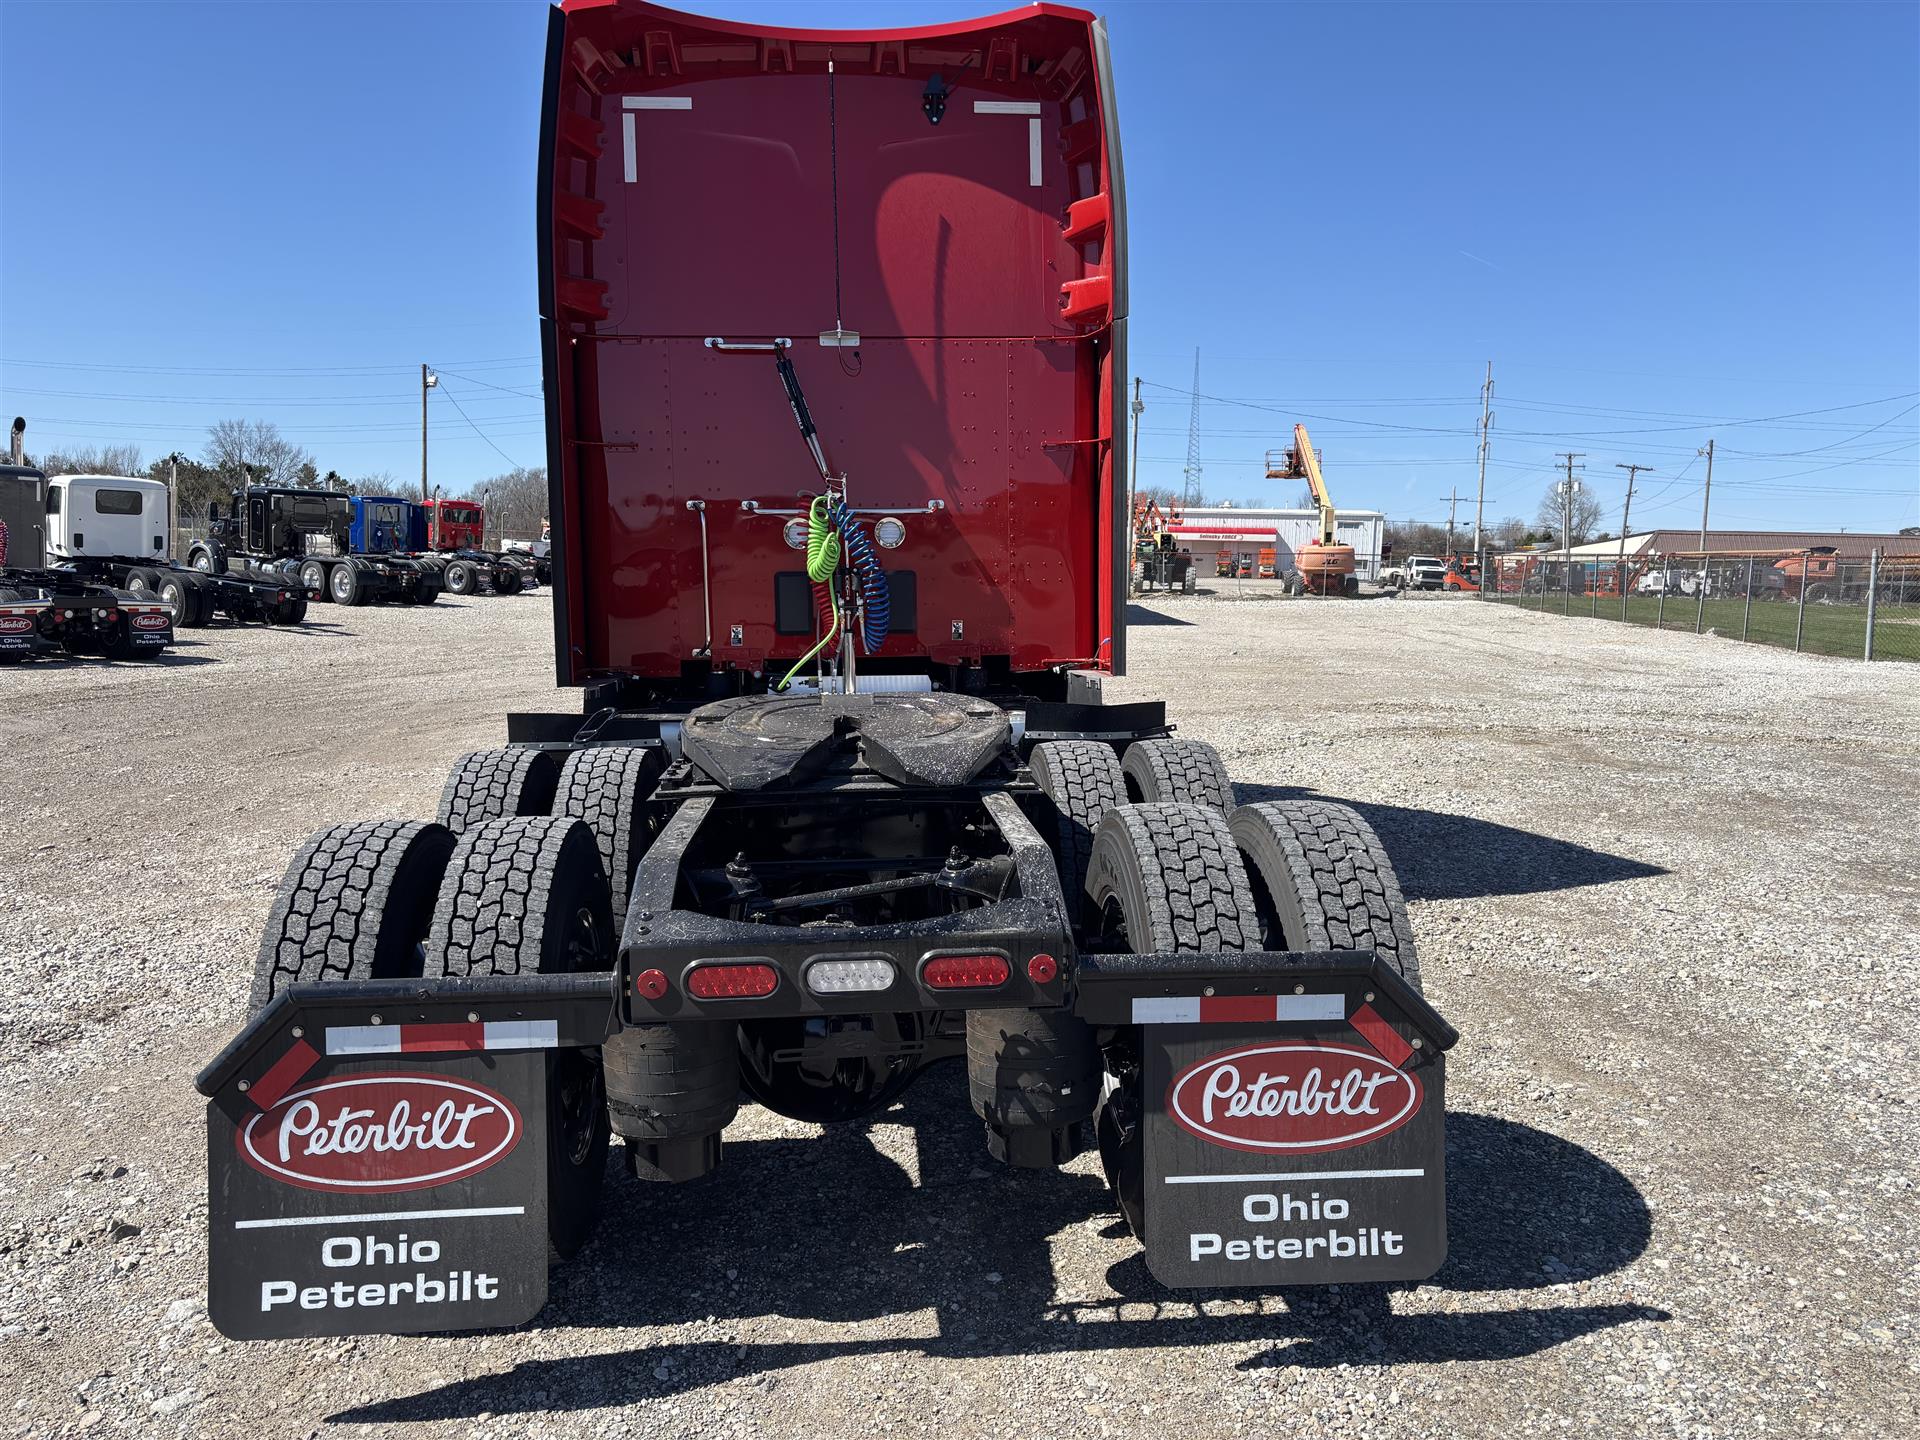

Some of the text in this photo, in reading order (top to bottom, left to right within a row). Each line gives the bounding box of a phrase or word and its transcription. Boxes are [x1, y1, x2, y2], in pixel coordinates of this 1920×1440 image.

[136, 617, 164, 626] Peterbilt
[1202, 1064, 1398, 1124] Peterbilt
[278, 1099, 495, 1163] Peterbilt
[1242, 1192, 1350, 1223] Ohio
[321, 1233, 441, 1268] Ohio
[1189, 1227, 1404, 1262] Peterbilt
[260, 1269, 500, 1312] Peterbilt
